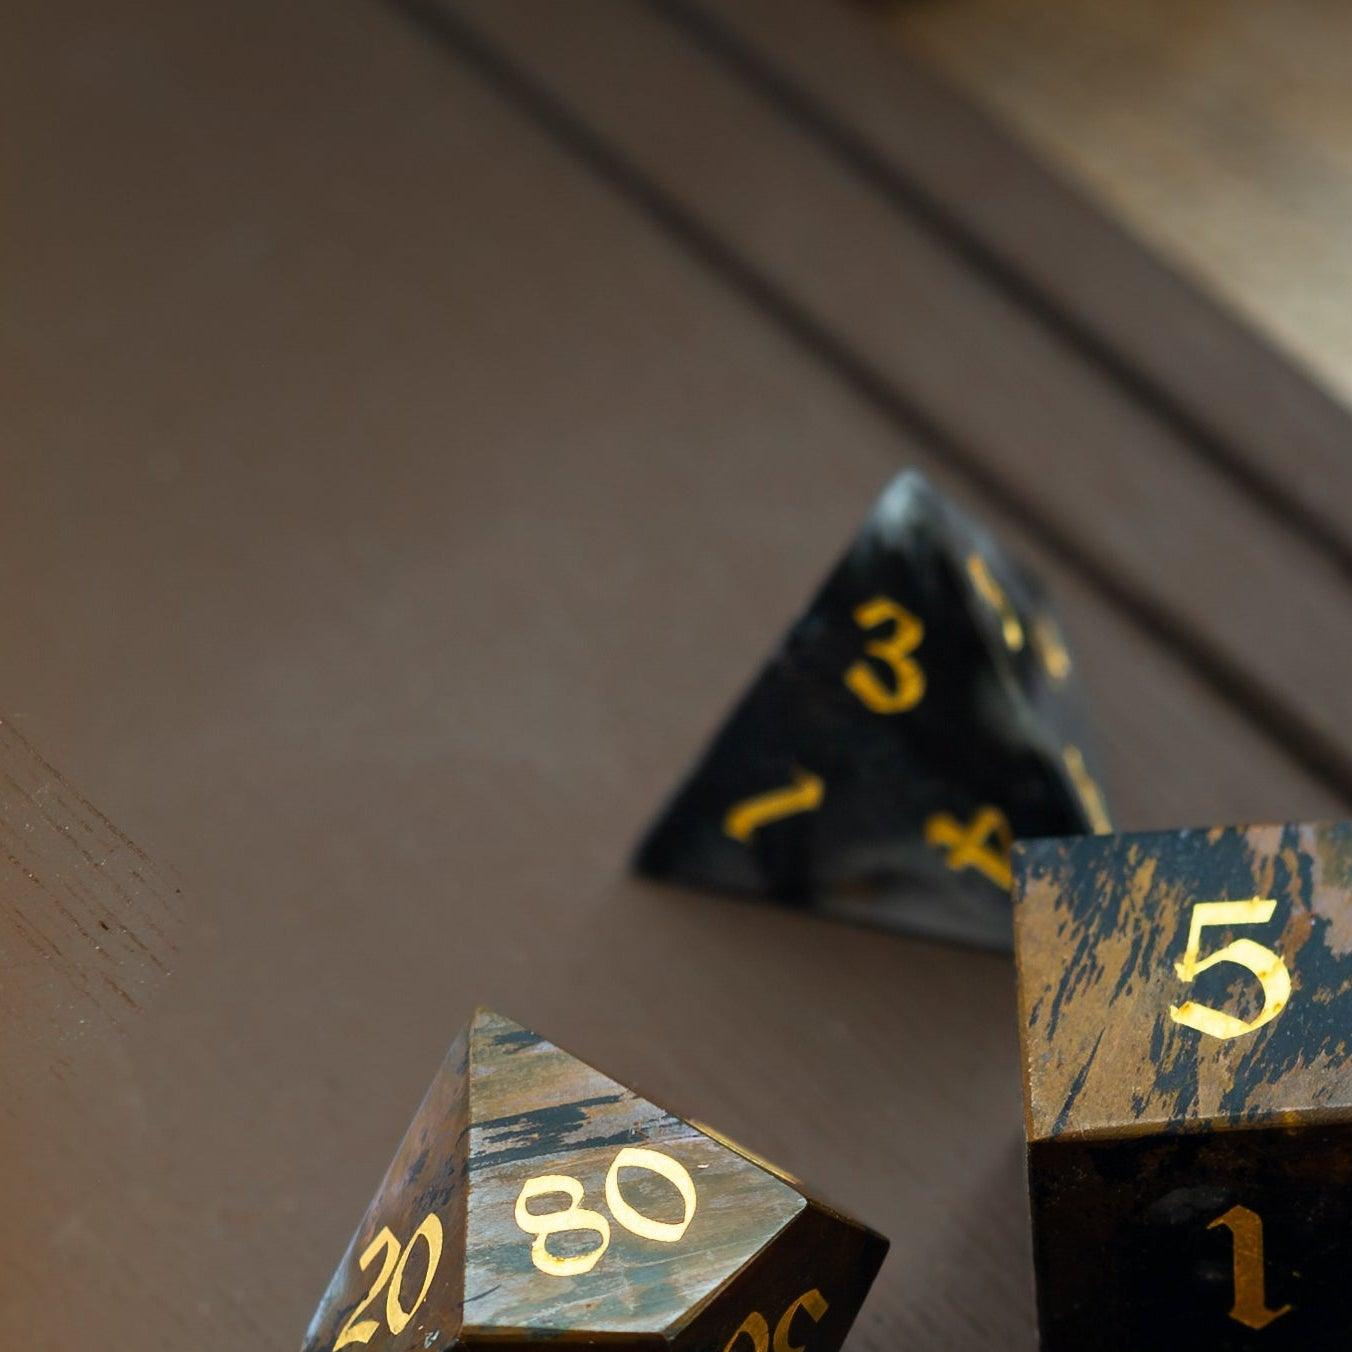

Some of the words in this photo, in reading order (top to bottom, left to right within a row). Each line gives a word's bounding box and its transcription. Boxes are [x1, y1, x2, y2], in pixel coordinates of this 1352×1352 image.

[846, 599, 925, 714] 3
[724, 774, 824, 842] 1
[1169, 897, 1292, 1041] 5
[514, 1147, 697, 1277] 80
[1206, 1204, 1292, 1330] 1
